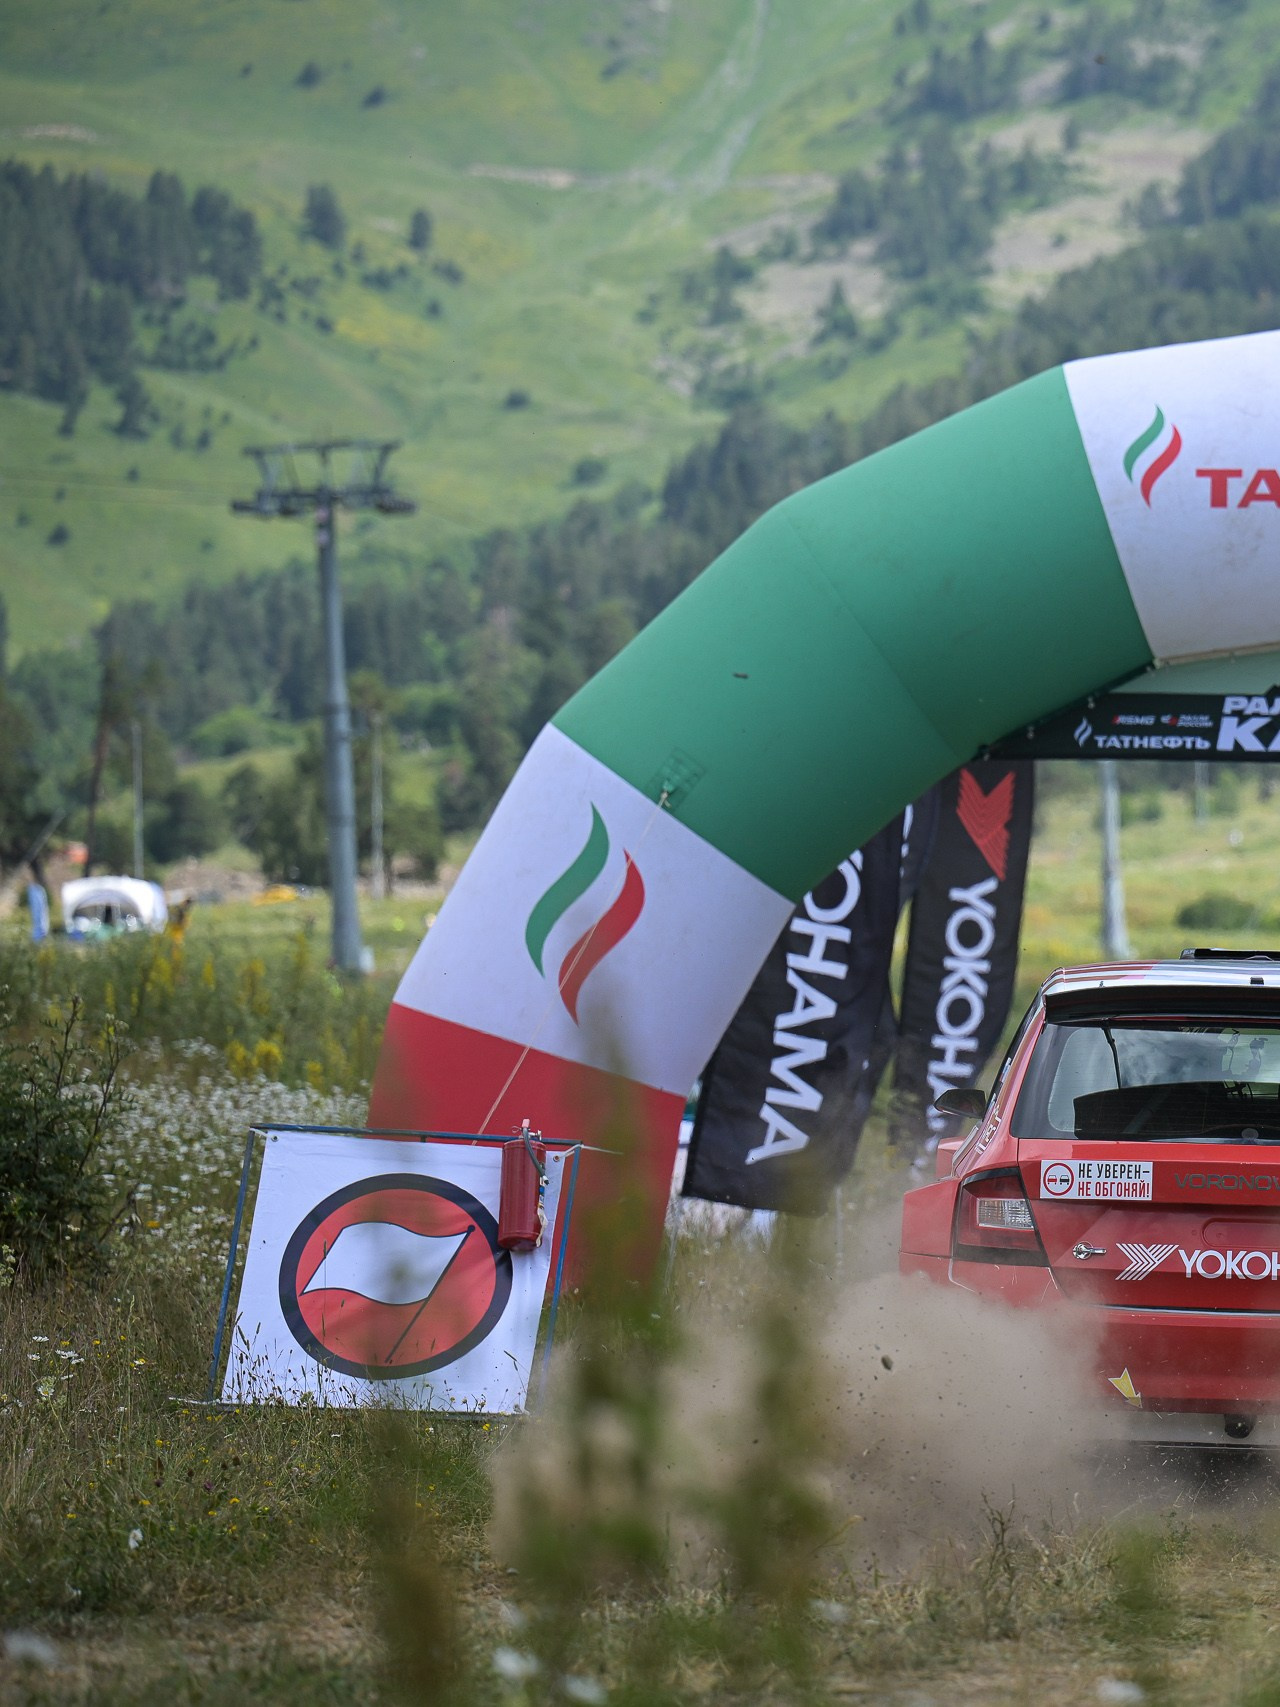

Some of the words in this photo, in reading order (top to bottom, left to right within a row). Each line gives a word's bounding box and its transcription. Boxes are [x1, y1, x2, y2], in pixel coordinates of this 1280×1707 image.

[1094, 734, 1212, 750] ТАТНЕФТЬ
[745, 849, 864, 1166] OHAMA
[912, 876, 999, 1172] YOKOH
[1078, 1162, 1093, 1179] НЕ
[1077, 1181, 1091, 1197] НЕ
[1095, 1179, 1150, 1198] ОБГОНЯЙ!
